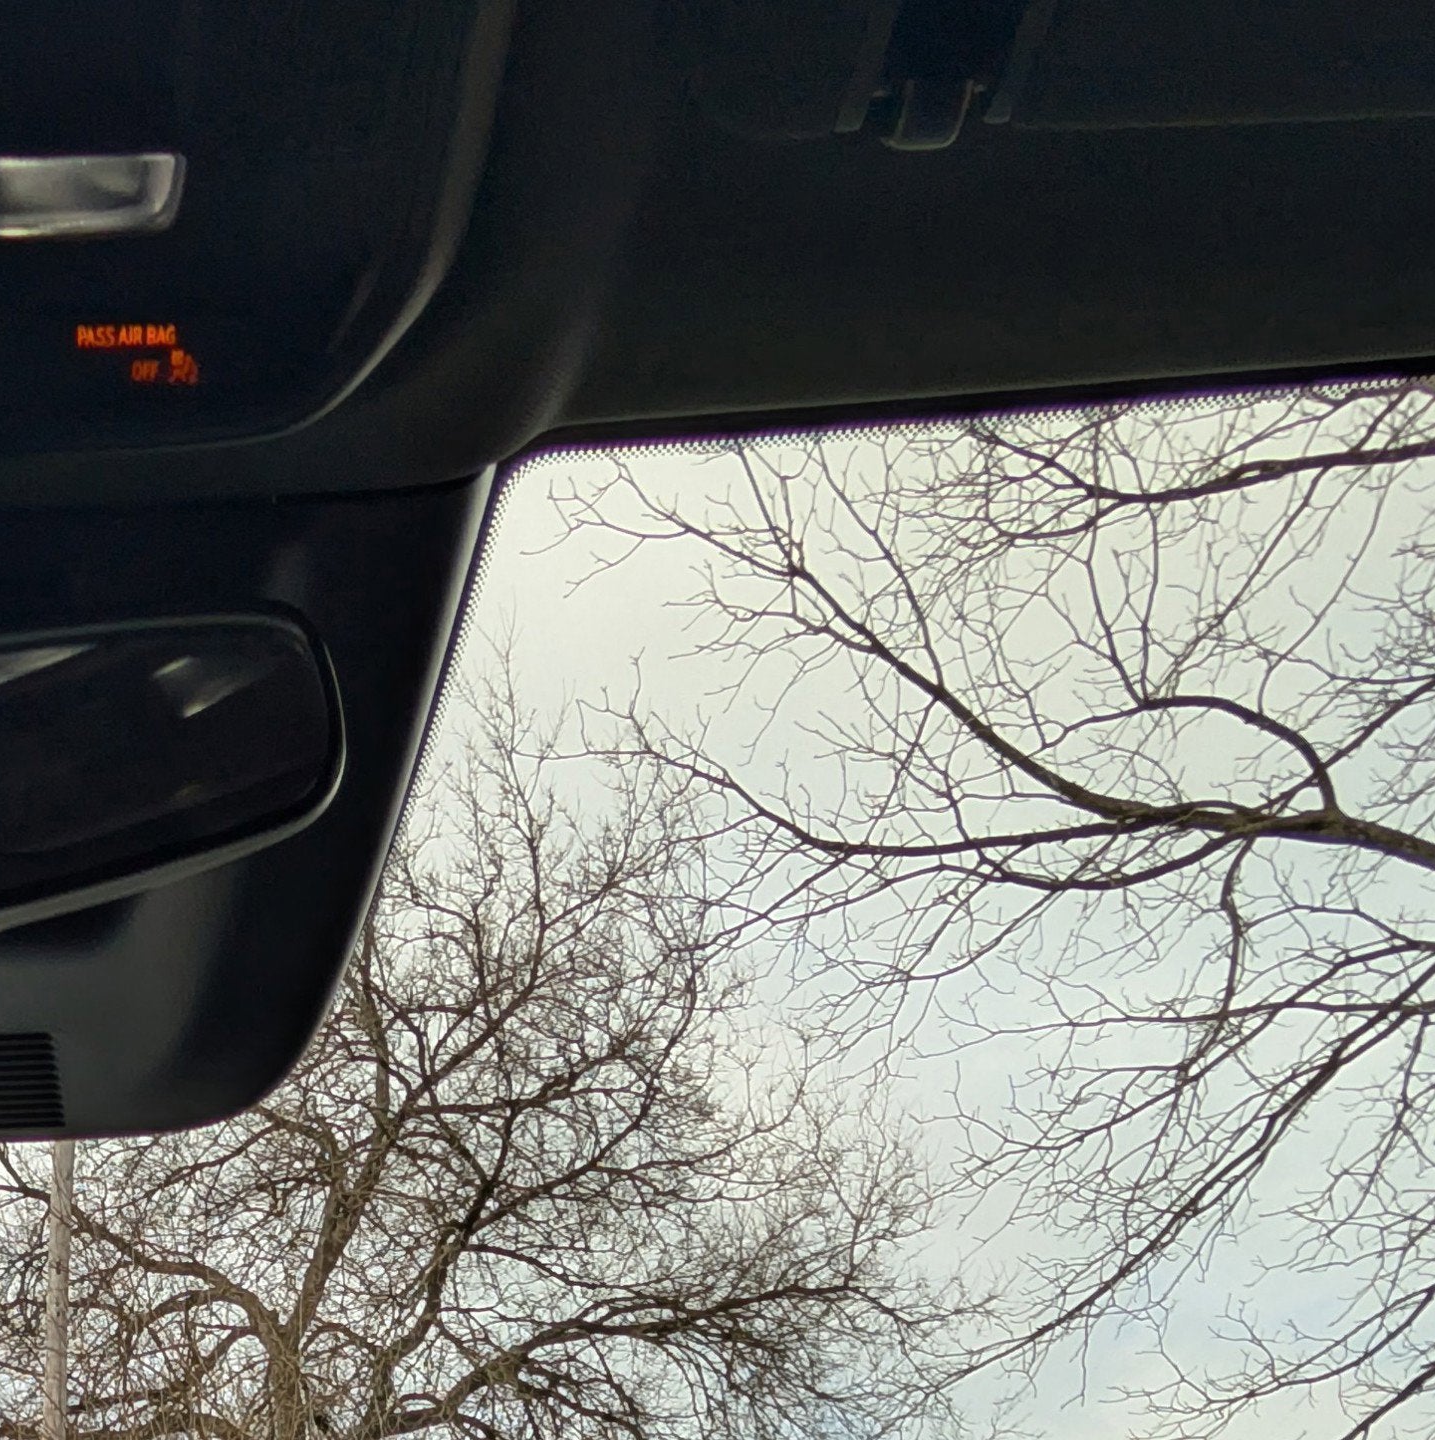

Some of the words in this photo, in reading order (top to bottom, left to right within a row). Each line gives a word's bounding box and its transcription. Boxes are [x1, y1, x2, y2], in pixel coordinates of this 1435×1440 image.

[76, 324, 115, 347] PASS
[118, 324, 142, 345] AIR
[146, 323, 176, 345] BAG
[132, 359, 159, 382] OFF
